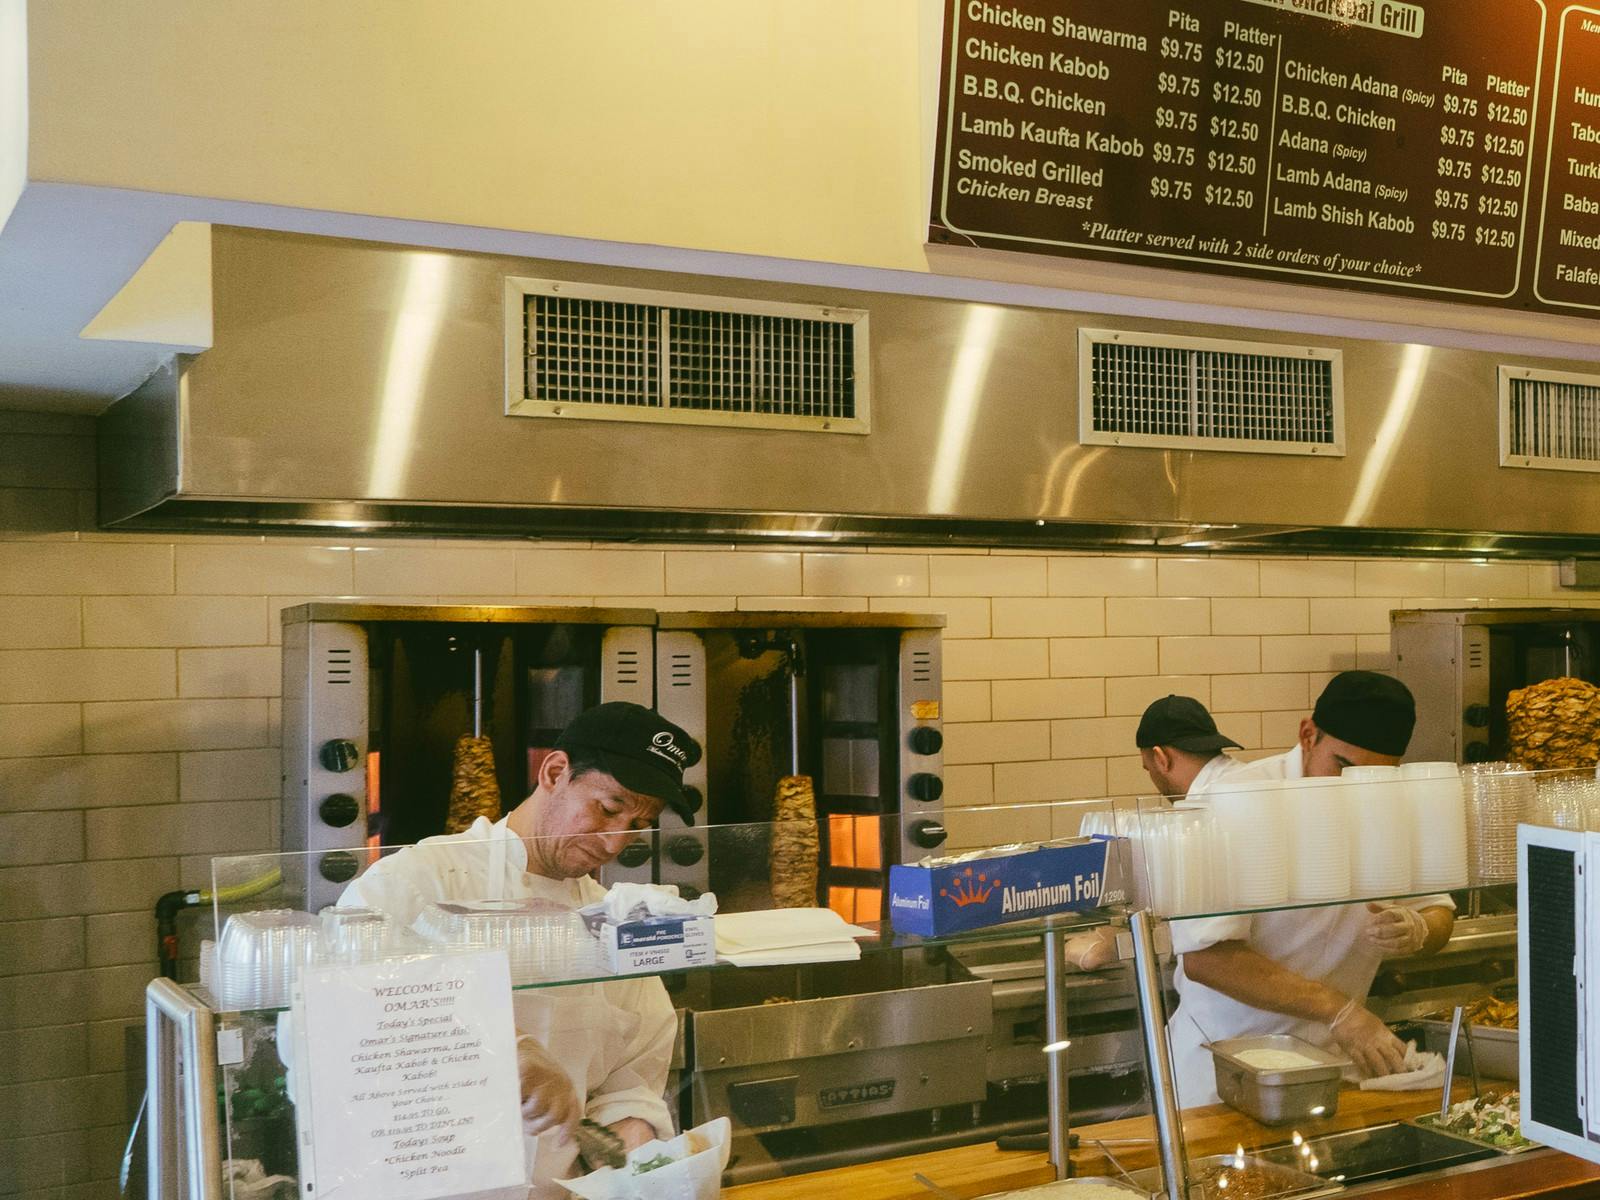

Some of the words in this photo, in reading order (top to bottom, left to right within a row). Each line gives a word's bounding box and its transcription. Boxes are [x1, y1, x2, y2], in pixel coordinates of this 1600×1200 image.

[968, 0, 1046, 33] Chicken
[1052, 15, 1147, 51] Shawarma
[1160, 36, 1202, 62] $9.75
[1215, 47, 1264, 74] $12.50
[1169, 10, 1199, 32] Pita
[1224, 21, 1276, 47] Platter
[1380, 4, 1417, 33] Grill
[965, 37, 1043, 69] Chicken
[1049, 52, 1109, 80] Kabob
[963, 74, 1024, 104] B.B.Q.
[1031, 86, 1105, 116] Chicken
[1285, 60, 1347, 89] Chicken
[1350, 73, 1398, 99] Adana
[1402, 88, 1435, 108] (Spicy)
[1442, 66, 1468, 86] Pita
[1487, 75, 1530, 98] Platter
[1282, 94, 1331, 120] B.B.Q.
[1336, 104, 1396, 132] Chicken
[961, 112, 1015, 138] Lamb
[1021, 121, 1080, 148] Kaufta
[1086, 130, 1144, 157] Kabob
[1278, 129, 1328, 154] Adana
[1332, 144, 1367, 163] (Spicy)
[958, 149, 1037, 178] Smoked
[1042, 161, 1103, 187] Grilled
[1277, 163, 1320, 186] Lamb
[1323, 171, 1371, 194] Adana
[1375, 184, 1408, 202] (Spicy)
[957, 177, 1030, 202] Chicken
[1035, 187, 1093, 210] Breast
[1563, 193, 1599, 214] Baba
[1274, 197, 1317, 220] Lamb
[1321, 204, 1363, 226] Shish
[1368, 211, 1415, 234] Kabob
[1432, 220, 1466, 241] $9.75
[1475, 226, 1515, 248] $12.50
[1560, 229, 1600, 250] Mixed
[1146, 234, 1196, 250] served
[1199, 237, 1229, 254] with
[1233, 240, 1243, 255] 2
[1245, 243, 1274, 260] side
[1277, 248, 1320, 265] orders
[1323, 253, 1341, 271] of
[1338, 258, 1371, 272] your
[892, 892, 918, 910] Aluminum
[918, 895, 930, 910] Foil
[1002, 881, 1072, 914] Aluminum
[1075, 872, 1100, 900] Foil
[633, 956, 665, 967] LARGE
[372, 982, 443, 998] WELCOME
[446, 979, 464, 990] TO
[417, 1013, 453, 1026] Special
